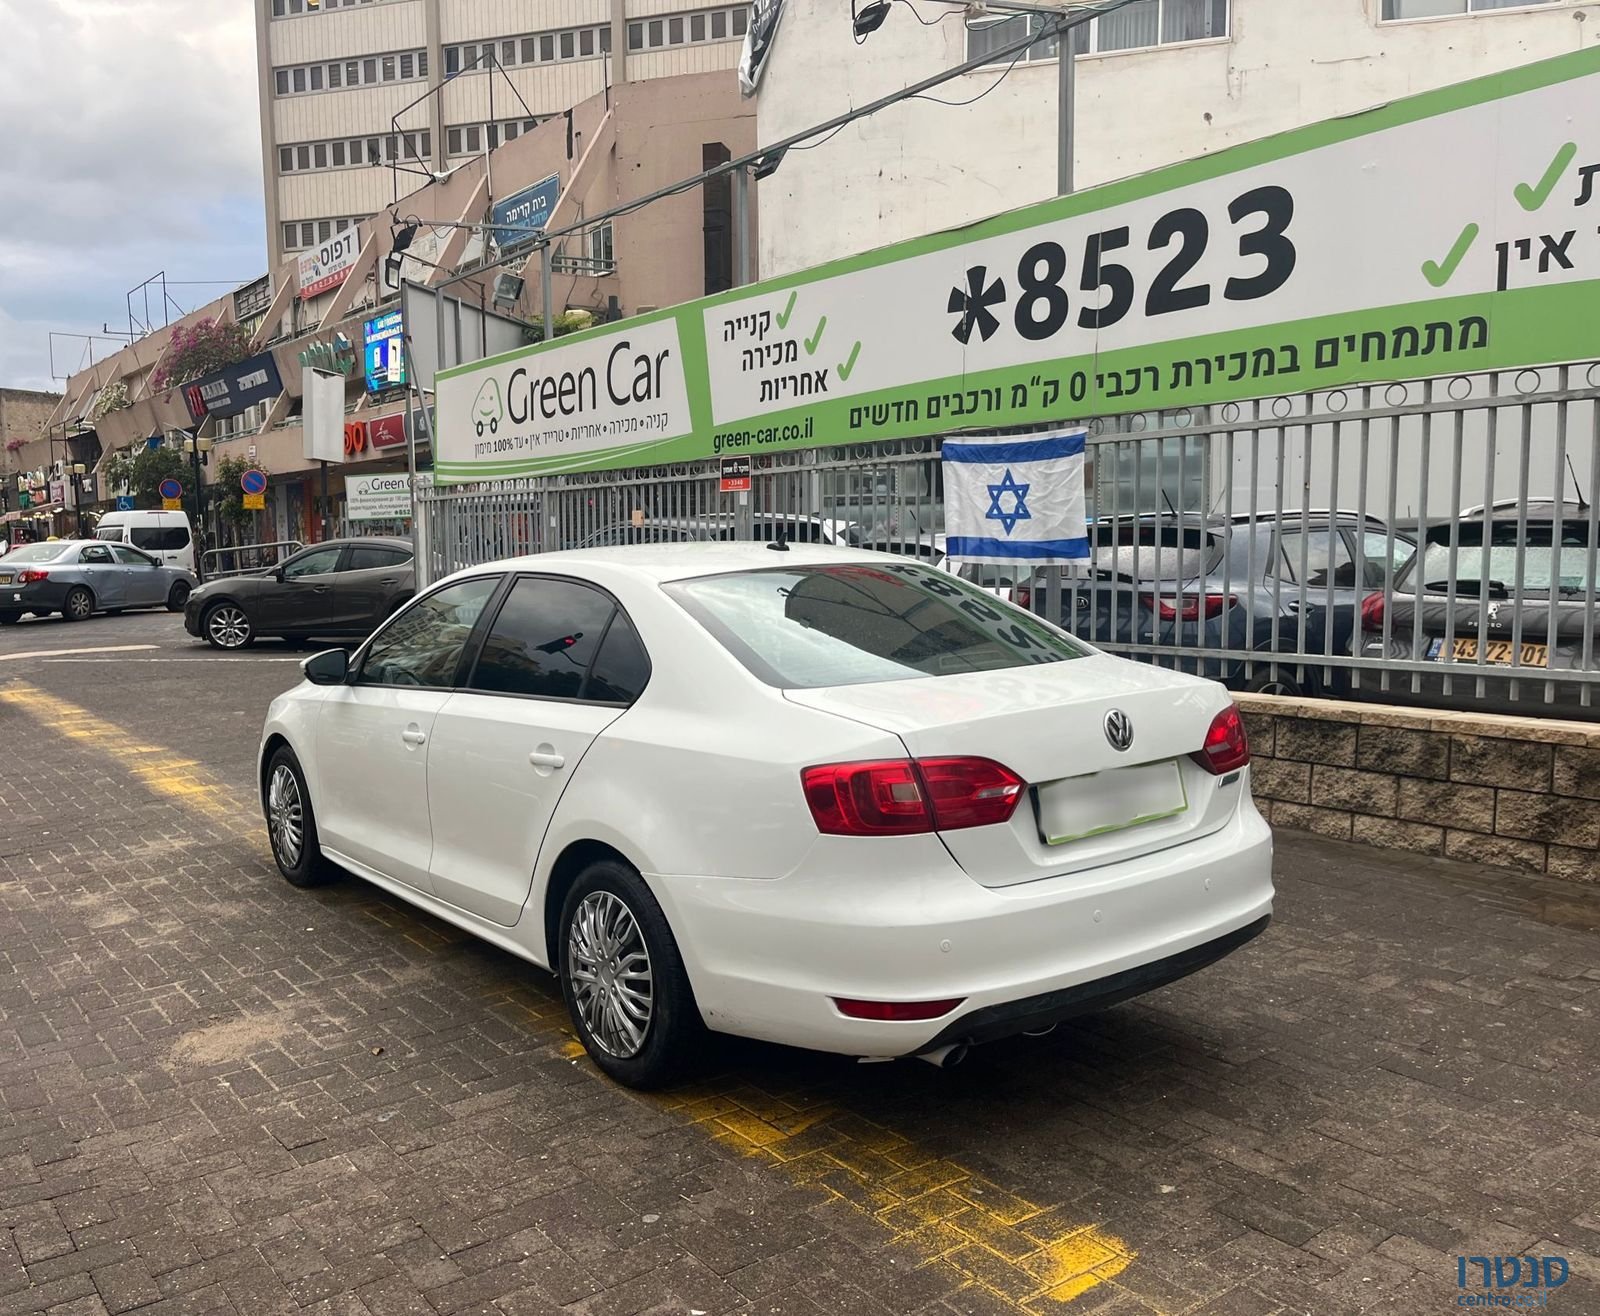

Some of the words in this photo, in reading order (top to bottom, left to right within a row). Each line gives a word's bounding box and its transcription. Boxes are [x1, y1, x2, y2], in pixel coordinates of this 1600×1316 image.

[506, 202, 531, 223] קדימה
[532, 195, 547, 212] בית
[320, 234, 351, 267] דפוס
[1495, 229, 1577, 292] אין
[723, 310, 771, 342] קנייה
[742, 339, 798, 372] מכירה
[1314, 315, 1488, 369] מתמחים
[1096, 365, 1160, 398] רכבי
[1169, 344, 1301, 389] במכירת
[507, 367, 597, 425] Green
[606, 341, 670, 406] Car
[759, 368, 829, 403] אחריות
[1069, 371, 1087, 402] 0
[849, 399, 919, 429] חדשים
[926, 387, 1002, 419] ורכבים
[570, 423, 602, 441] אחריות
[609, 417, 638, 435] מכירה
[646, 411, 669, 432] קניה
[713, 416, 814, 454] green-car.co.il
[474, 440, 492, 459] מימון
[493, 437, 514, 453] 100%
[513, 436, 524, 449] עד
[529, 432, 541, 450] אין
[543, 429, 564, 445] טרייד
[371, 478, 405, 491] Green
